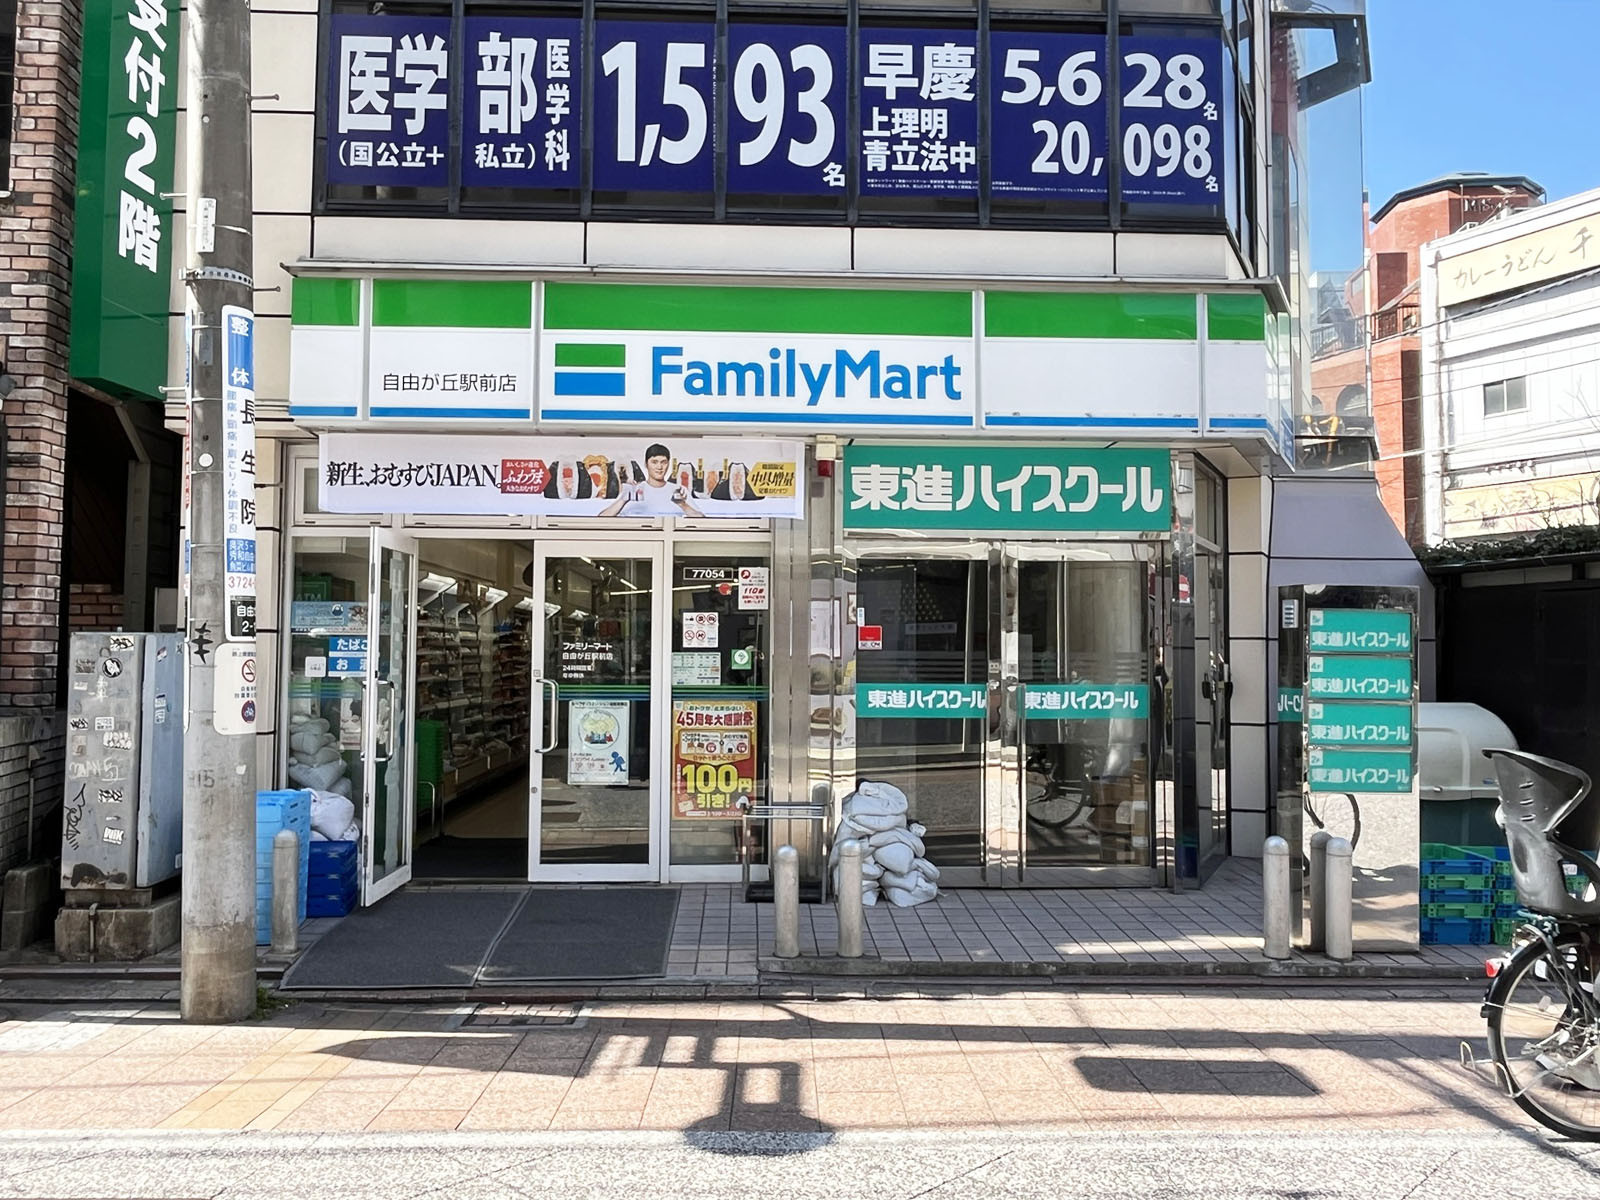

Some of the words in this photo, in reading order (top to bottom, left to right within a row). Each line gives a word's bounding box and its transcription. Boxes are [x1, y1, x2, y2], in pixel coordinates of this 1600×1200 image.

[338, 32, 538, 137] 医学部
[863, 42, 977, 102] 早慶
[544, 38, 571, 172] 医学科
[862, 107, 948, 139] 上理明
[862, 139, 977, 173] 青立法中
[1453, 245, 1556, 290] カレーうどん
[1568, 226, 1594, 260] 千
[231, 316, 250, 386] 整体
[382, 371, 518, 394] 自由が丘駅前店
[651, 346, 962, 406] FamilyMart
[240, 399, 256, 525] 長生院
[325, 460, 502, 489] 新生、おむすびJAPAN。
[503, 468, 545, 485] ふわうま
[850, 465, 1164, 513] 東進ハイスクール
[692, 569, 725, 578] 77054
[562, 642, 613, 651] ファミリーマート
[1311, 631, 1409, 648] 東進ハイスクール
[867, 690, 986, 709] 東進ハイスクール
[1024, 690, 1139, 710] 東進ハイスクール
[1311, 677, 1409, 694] 東進ハイスクール
[1311, 724, 1409, 741] 東進ハイスクール
[682, 764, 753, 793] 100円
[1311, 768, 1409, 784] 東進ハイスクール
